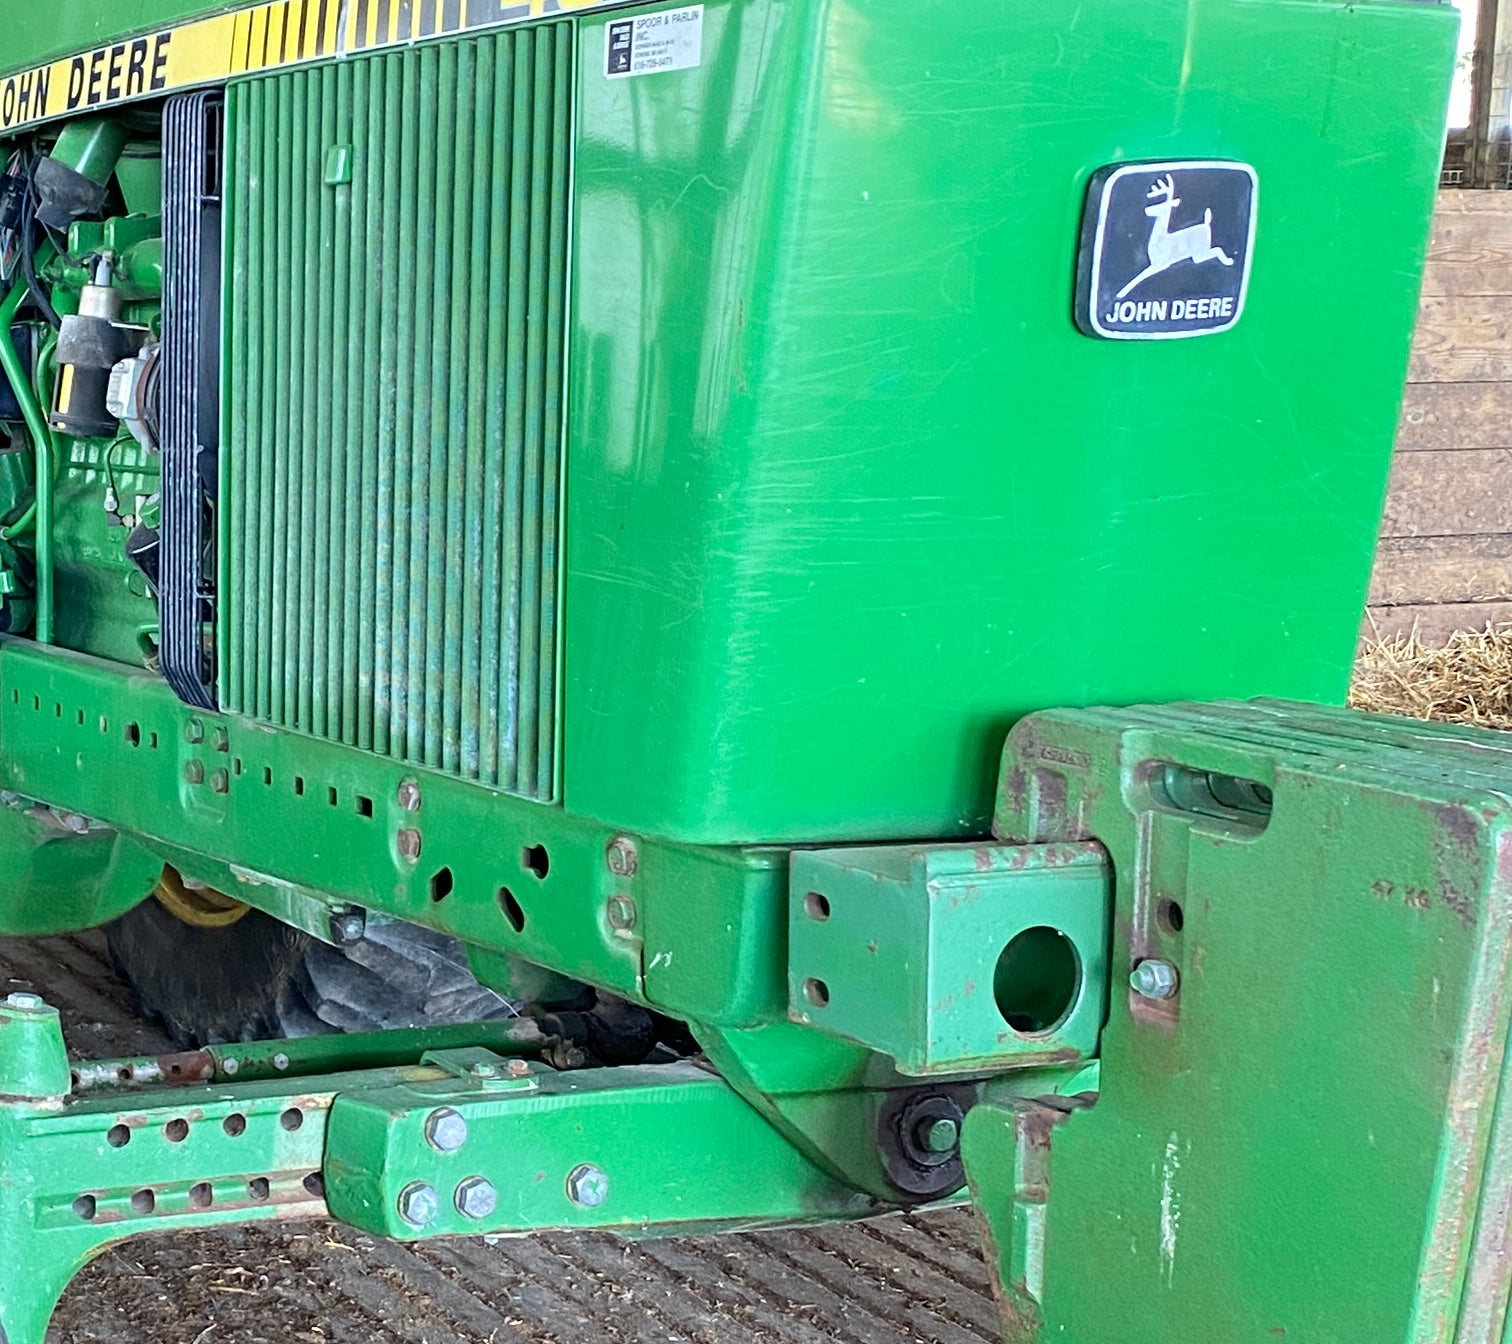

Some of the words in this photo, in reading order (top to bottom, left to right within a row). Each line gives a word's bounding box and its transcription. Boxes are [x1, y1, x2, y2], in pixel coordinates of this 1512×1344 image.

[66, 32, 172, 110] DEERE
[1106, 299, 1168, 323] JOHN
[1171, 297, 1234, 320] DEERE
